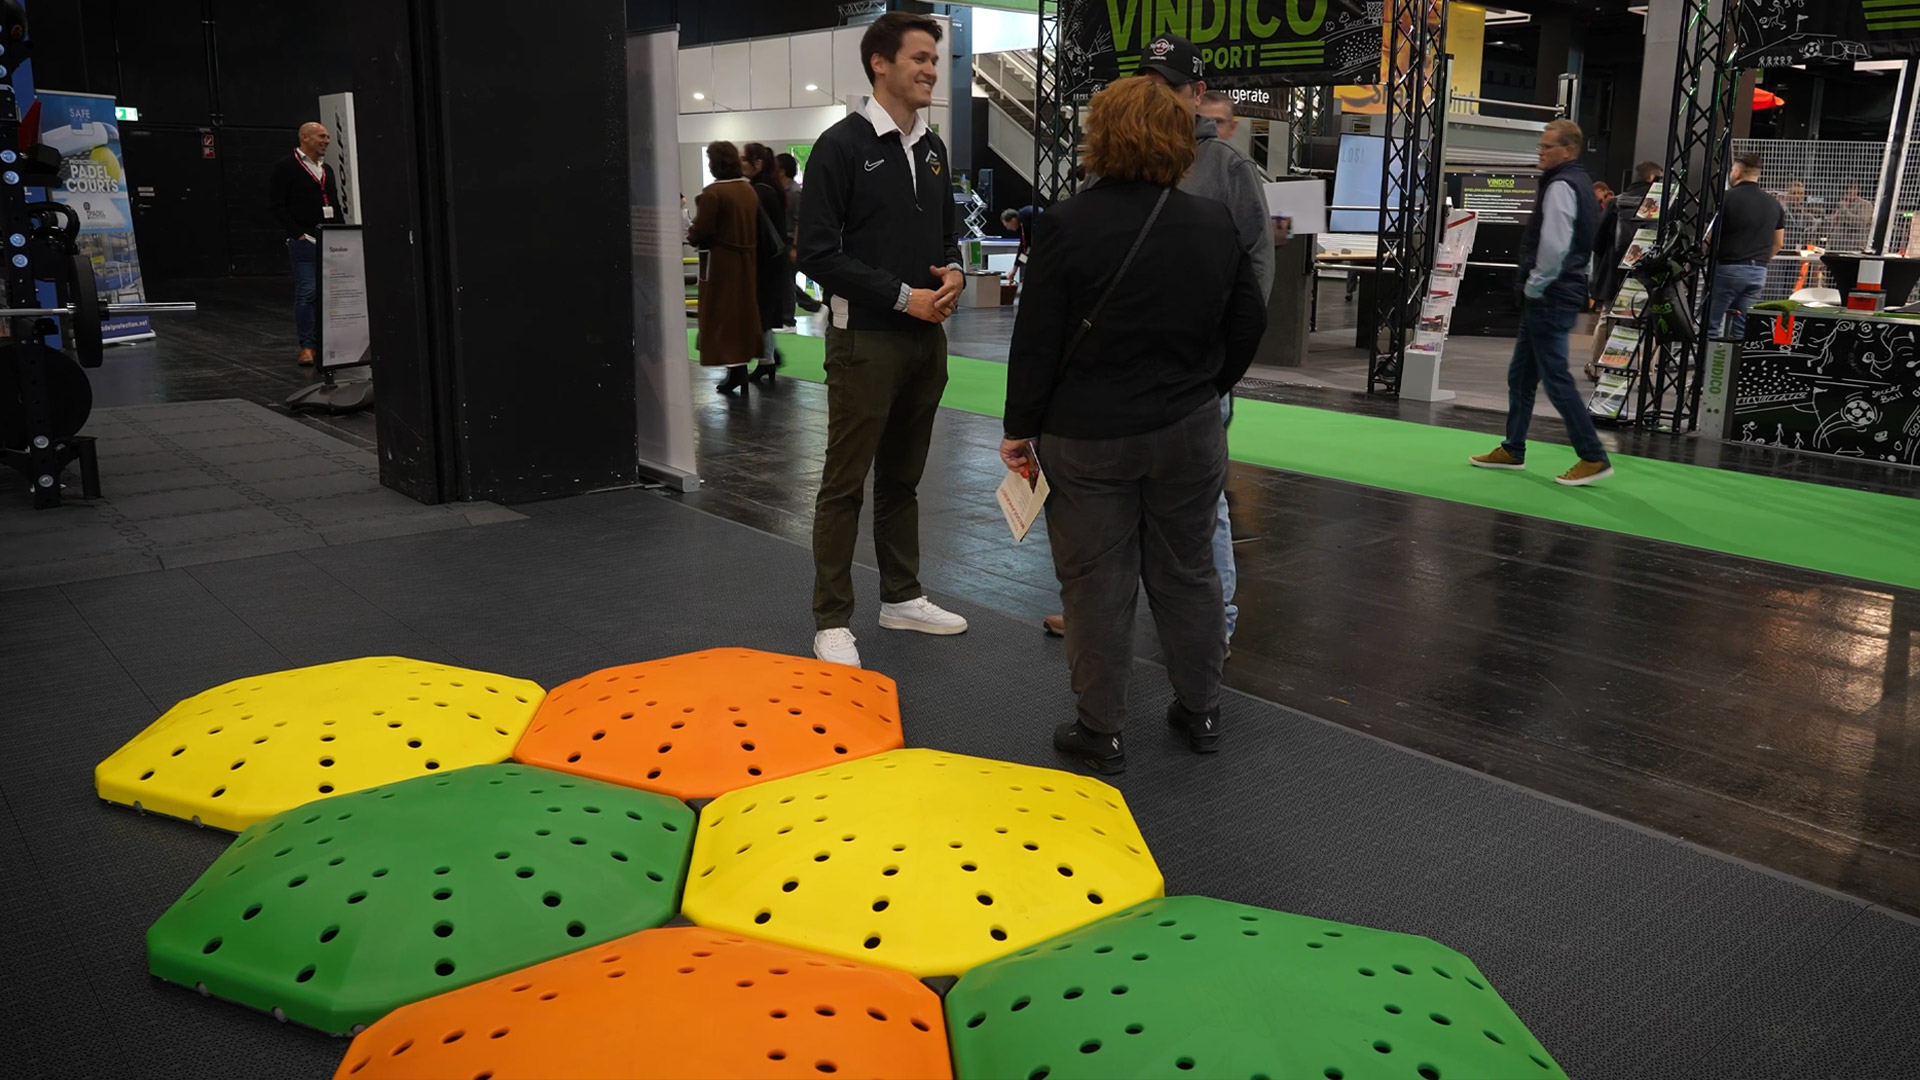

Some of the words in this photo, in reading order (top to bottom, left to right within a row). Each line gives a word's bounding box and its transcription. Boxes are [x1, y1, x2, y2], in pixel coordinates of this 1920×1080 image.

[1201, 45, 1255, 71] PORT
[69, 108, 91, 119] SAFE
[70, 165, 111, 179] PADEL
[66, 178, 119, 193] COURTS
[1487, 178, 1515, 186] VINDICO
[1742, 340, 1765, 350] cess
[1709, 349, 1726, 395] VINDICO
